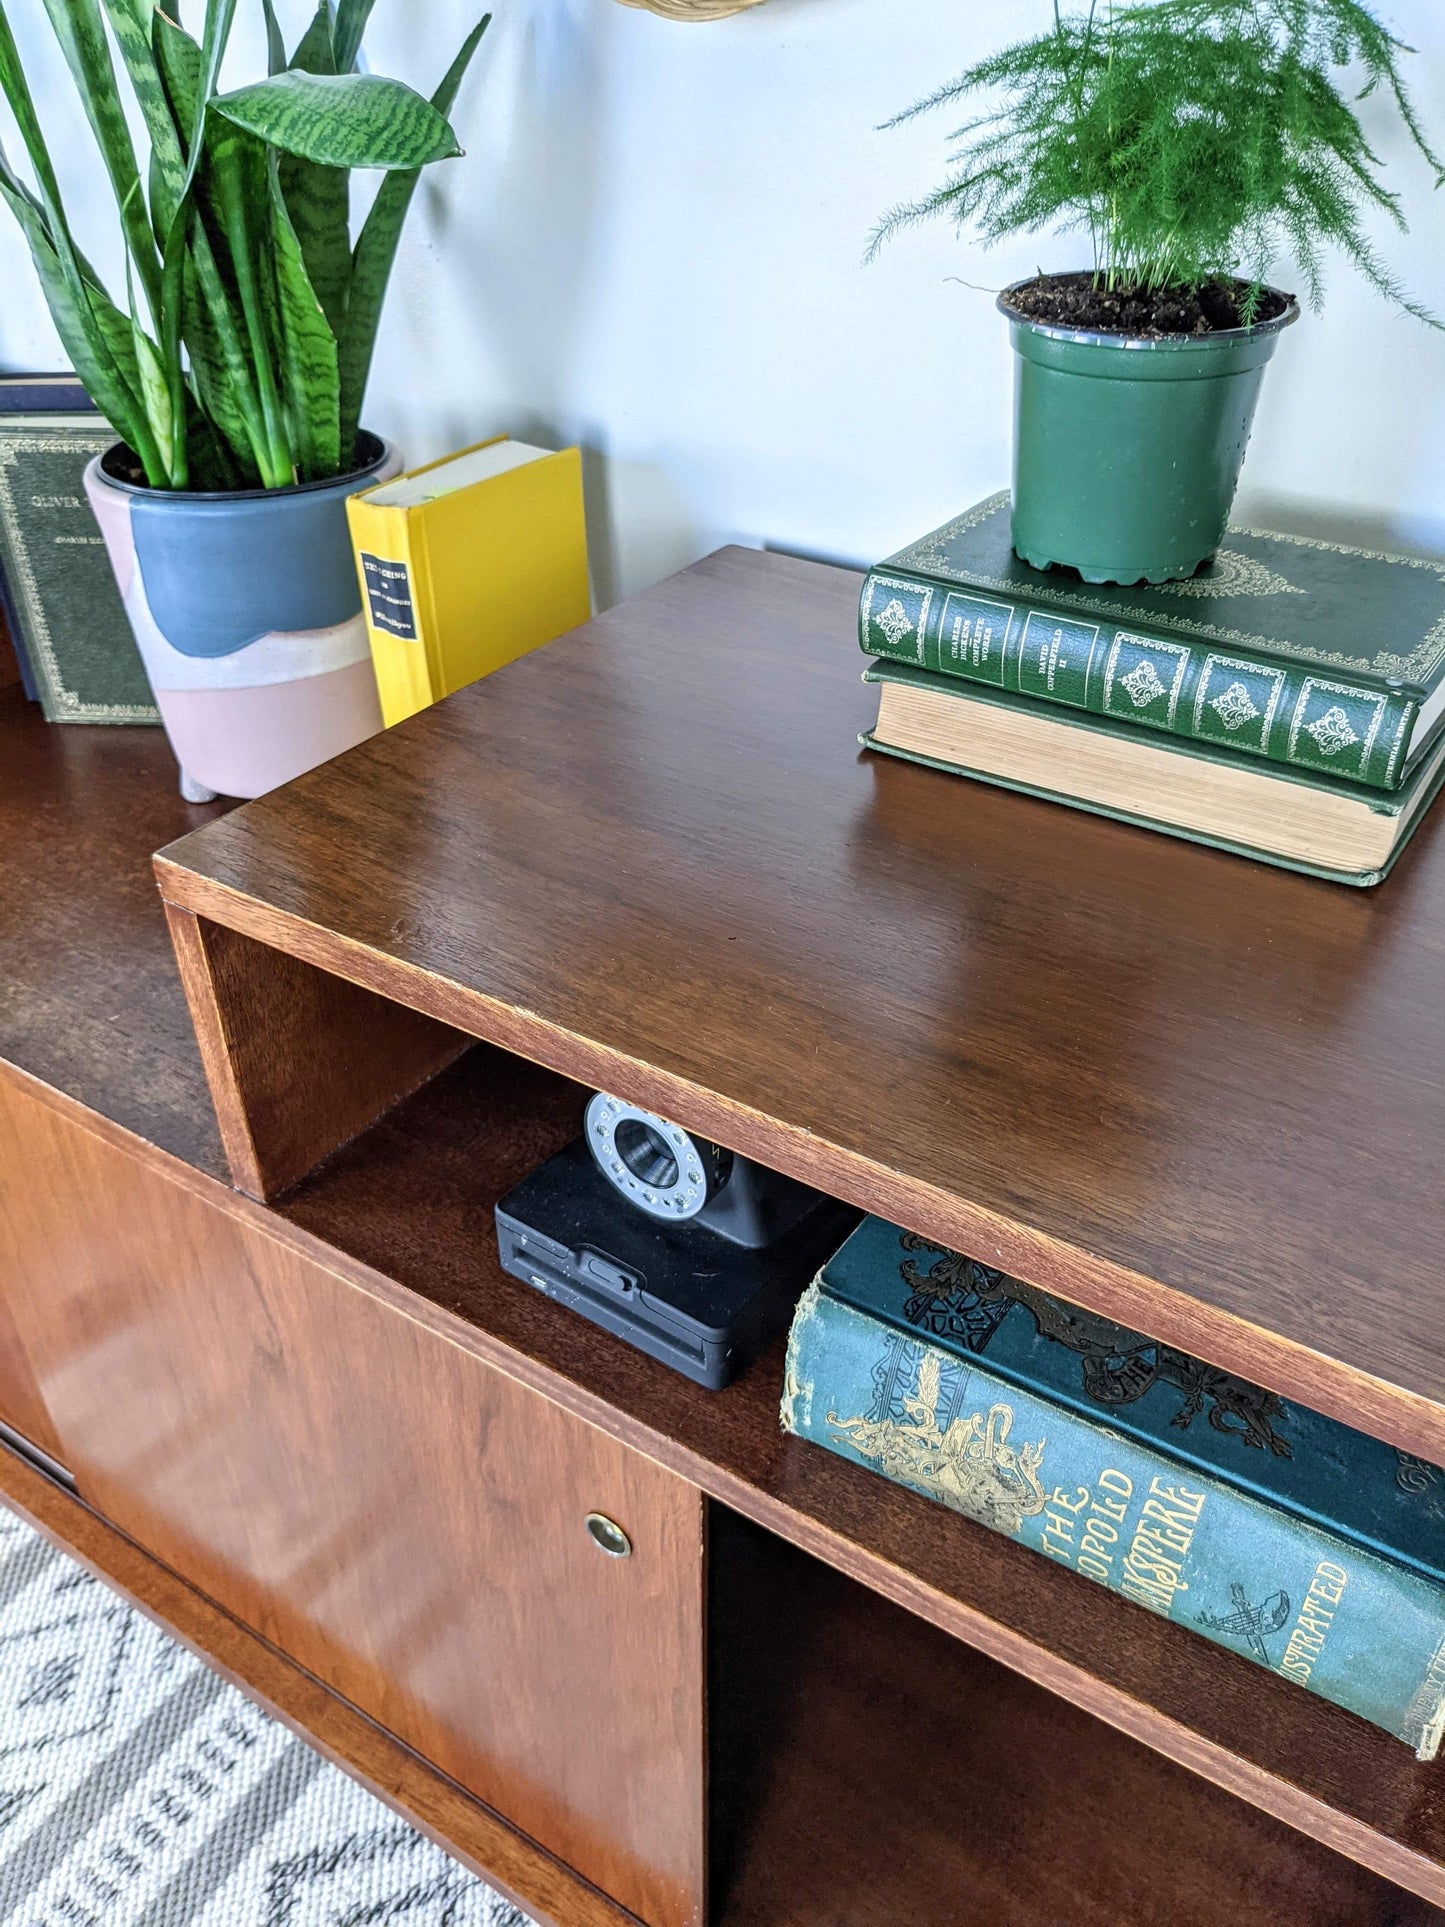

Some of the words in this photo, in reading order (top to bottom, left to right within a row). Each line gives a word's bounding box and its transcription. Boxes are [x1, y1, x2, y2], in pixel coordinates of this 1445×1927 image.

[31, 495, 81, 507] OLIVER
[951, 616, 962, 659] CHARLES
[960, 619, 971, 661] DICKENS
[972, 617, 985, 667] COMPLETE
[981, 627, 993, 661] WORKS
[1038, 644, 1049, 675] DAVID
[1046, 628, 1062, 692] COPPERFIELD
[1058, 659, 1068, 669] II
[1395, 700, 1414, 739] EDITION
[1040, 1486, 1089, 1560] THE
